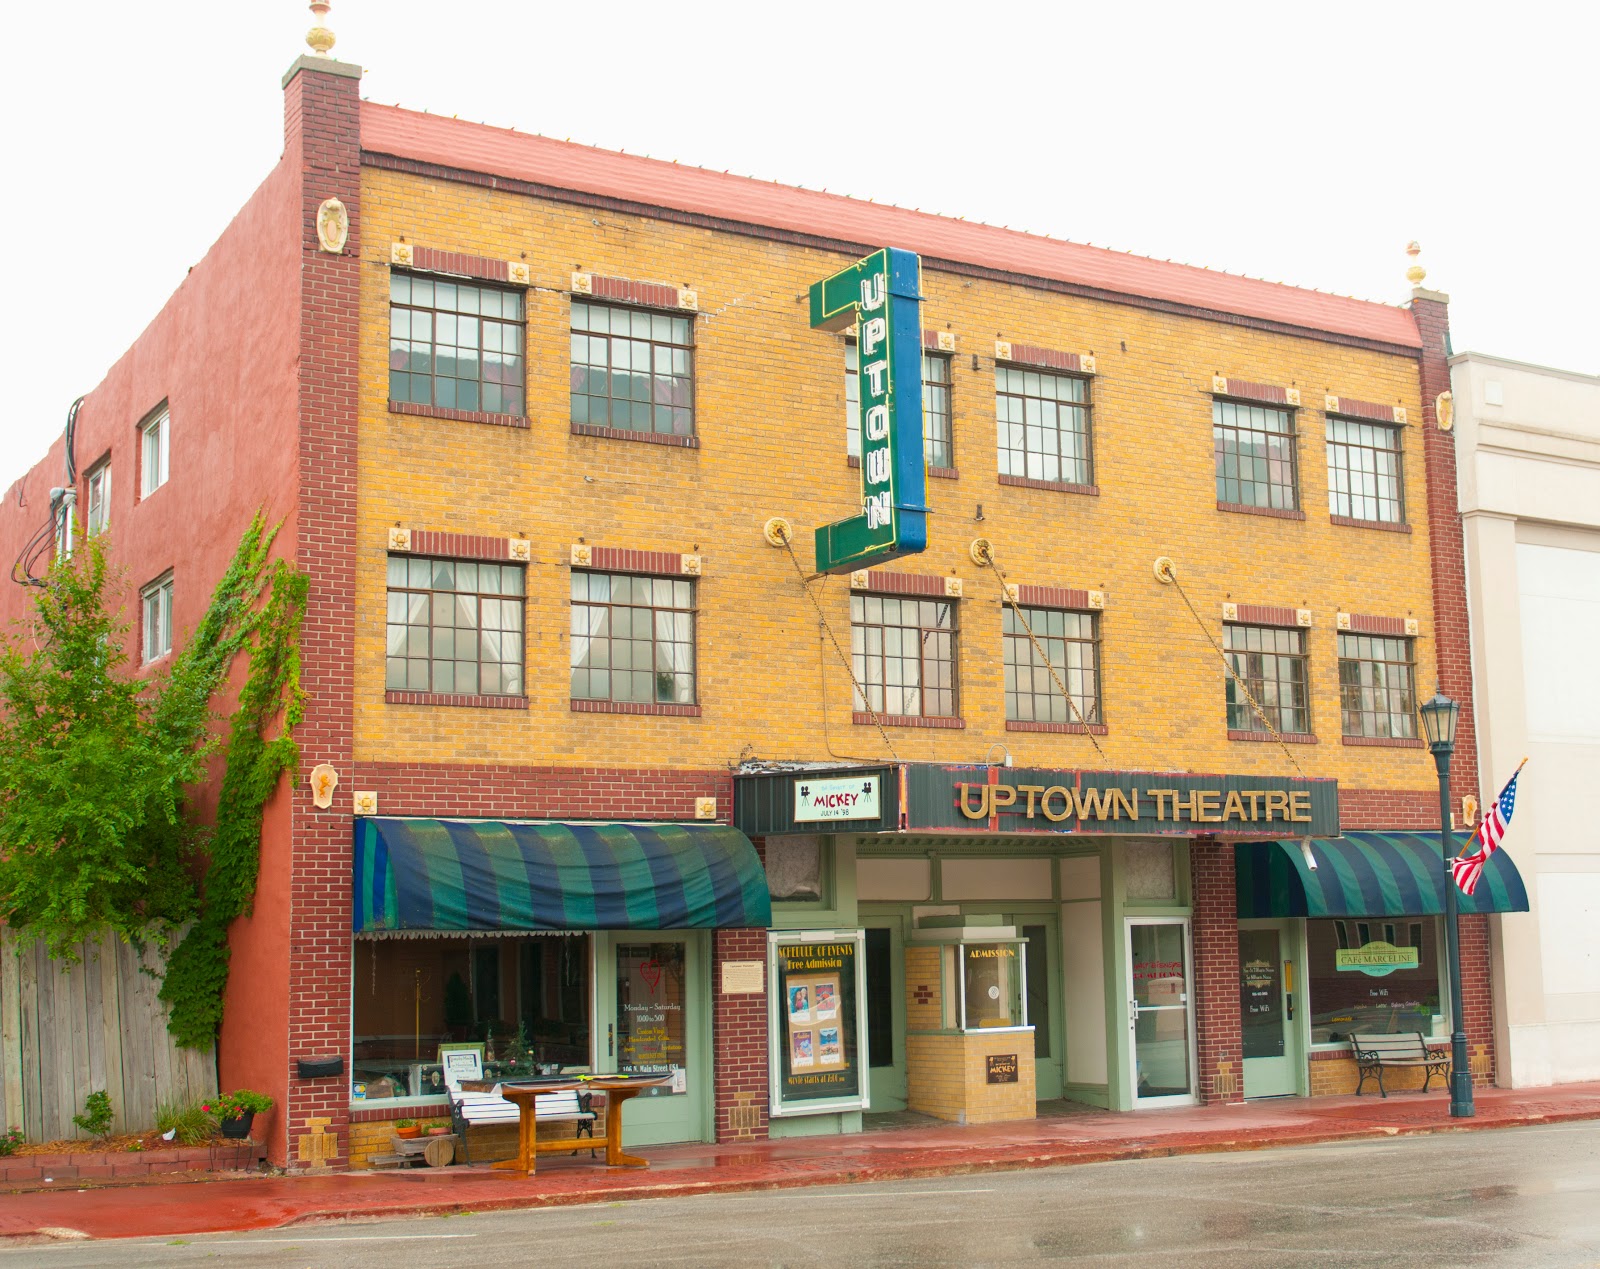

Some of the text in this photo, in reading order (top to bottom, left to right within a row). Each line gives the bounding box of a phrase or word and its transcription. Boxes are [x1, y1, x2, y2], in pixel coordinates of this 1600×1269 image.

[860, 272, 891, 530] UPTOWN
[814, 793, 859, 808] MICKEY
[961, 783, 1312, 823] UPTOWN THEATRE
[778, 944, 853, 958] SCHEDULE OF EVENTS
[969, 949, 1015, 958] ADMISSION
[787, 957, 842, 970] Free Admission
[1363, 954, 1413, 963] MARCELINE
[624, 1004, 649, 1012] Monday
[654, 1003, 681, 1011] Saturday
[639, 1064, 652, 1072] Main
[652, 1064, 668, 1072] Street
[989, 1065, 1016, 1074] MICKEY
